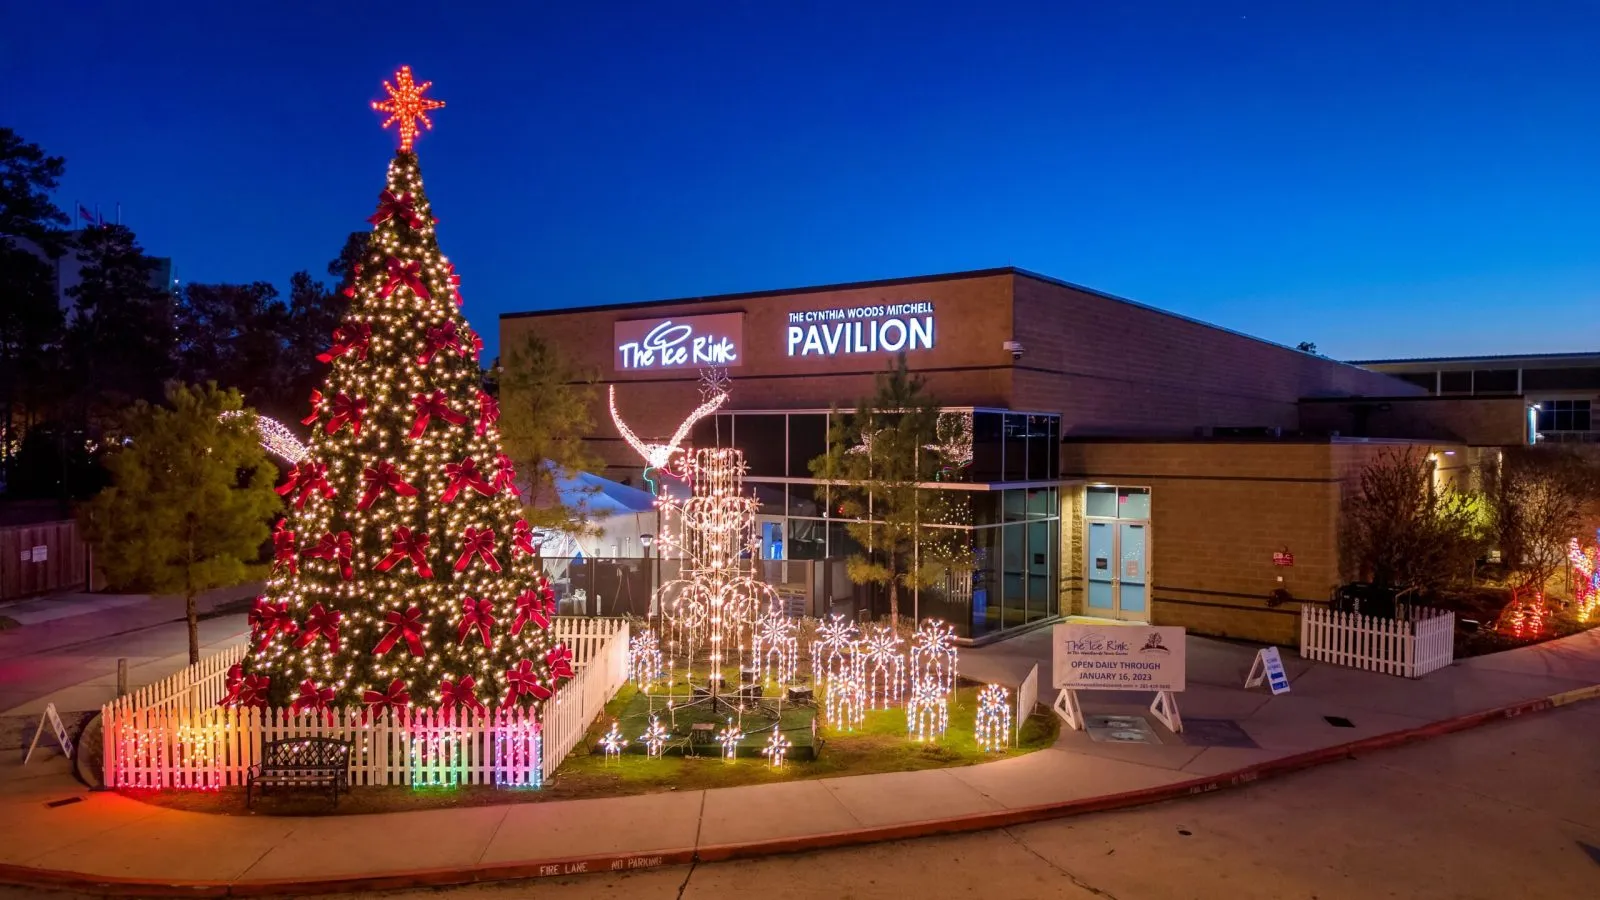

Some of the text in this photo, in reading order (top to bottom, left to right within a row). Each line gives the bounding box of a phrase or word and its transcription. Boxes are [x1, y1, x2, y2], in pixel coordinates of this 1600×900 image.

[789, 302, 933, 322] THE CYNTHIA WOODS MITCHELL
[787, 316, 933, 357] PAVILION
[619, 335, 737, 368] The Ice Rink
[1065, 640, 1129, 651] The Ice Rink
[1071, 661, 1160, 670] OPEN DAILY THROUGH
[1079, 672, 1152, 682] JANUARY 16, 2023
[540, 857, 662, 876] FIRE LANE NO PARKING
